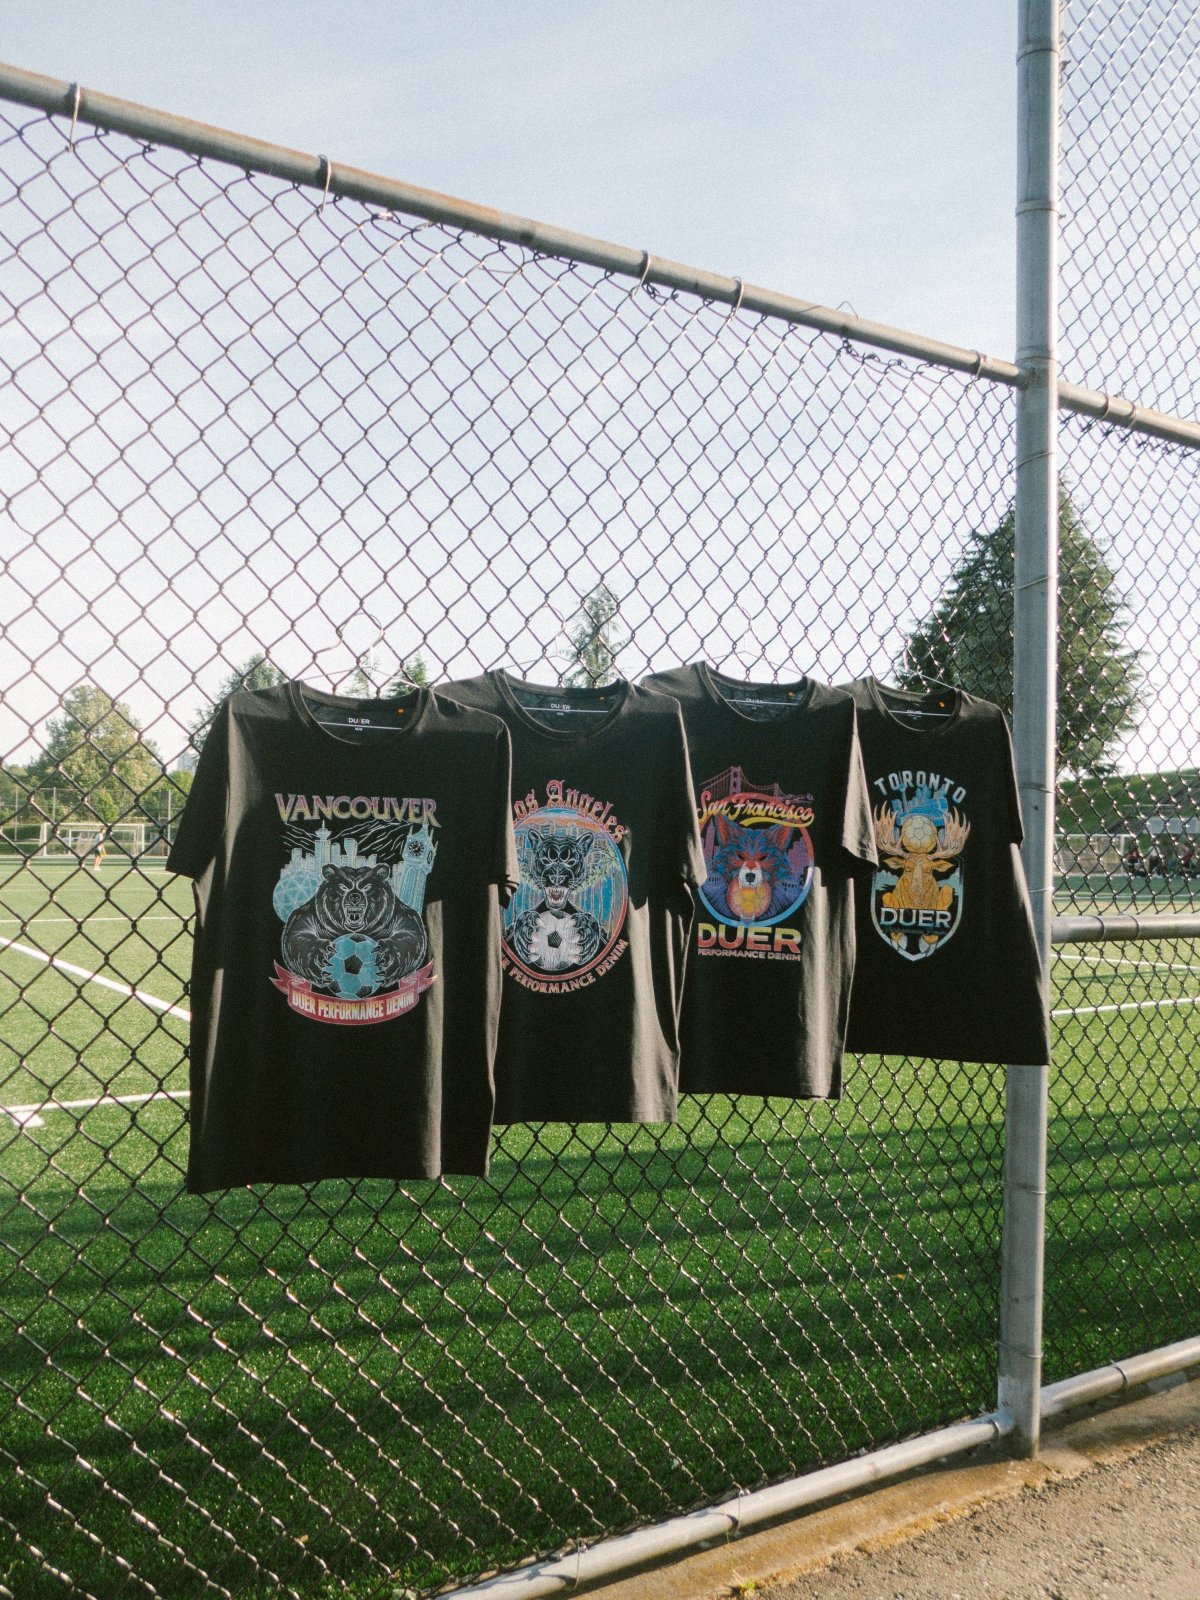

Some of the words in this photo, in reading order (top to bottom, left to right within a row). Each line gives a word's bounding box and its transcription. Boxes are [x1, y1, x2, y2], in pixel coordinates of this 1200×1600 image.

[873, 770, 967, 804] TORONTO
[275, 793, 441, 828] VANCOUVER
[546, 779, 629, 843] Angeles
[697, 790, 730, 821] San
[729, 797, 814, 827] Francisco
[879, 907, 952, 929] DUER
[697, 923, 802, 953] DUER
[697, 948, 766, 960] PERFORMANCE
[767, 951, 802, 962] DENIM
[509, 966, 596, 994] PERFORMANCE
[595, 938, 629, 976] DENIM
[291, 989, 316, 1014] DUER
[317, 999, 384, 1020] PERFORMANCE
[385, 988, 416, 1014] DENIM
